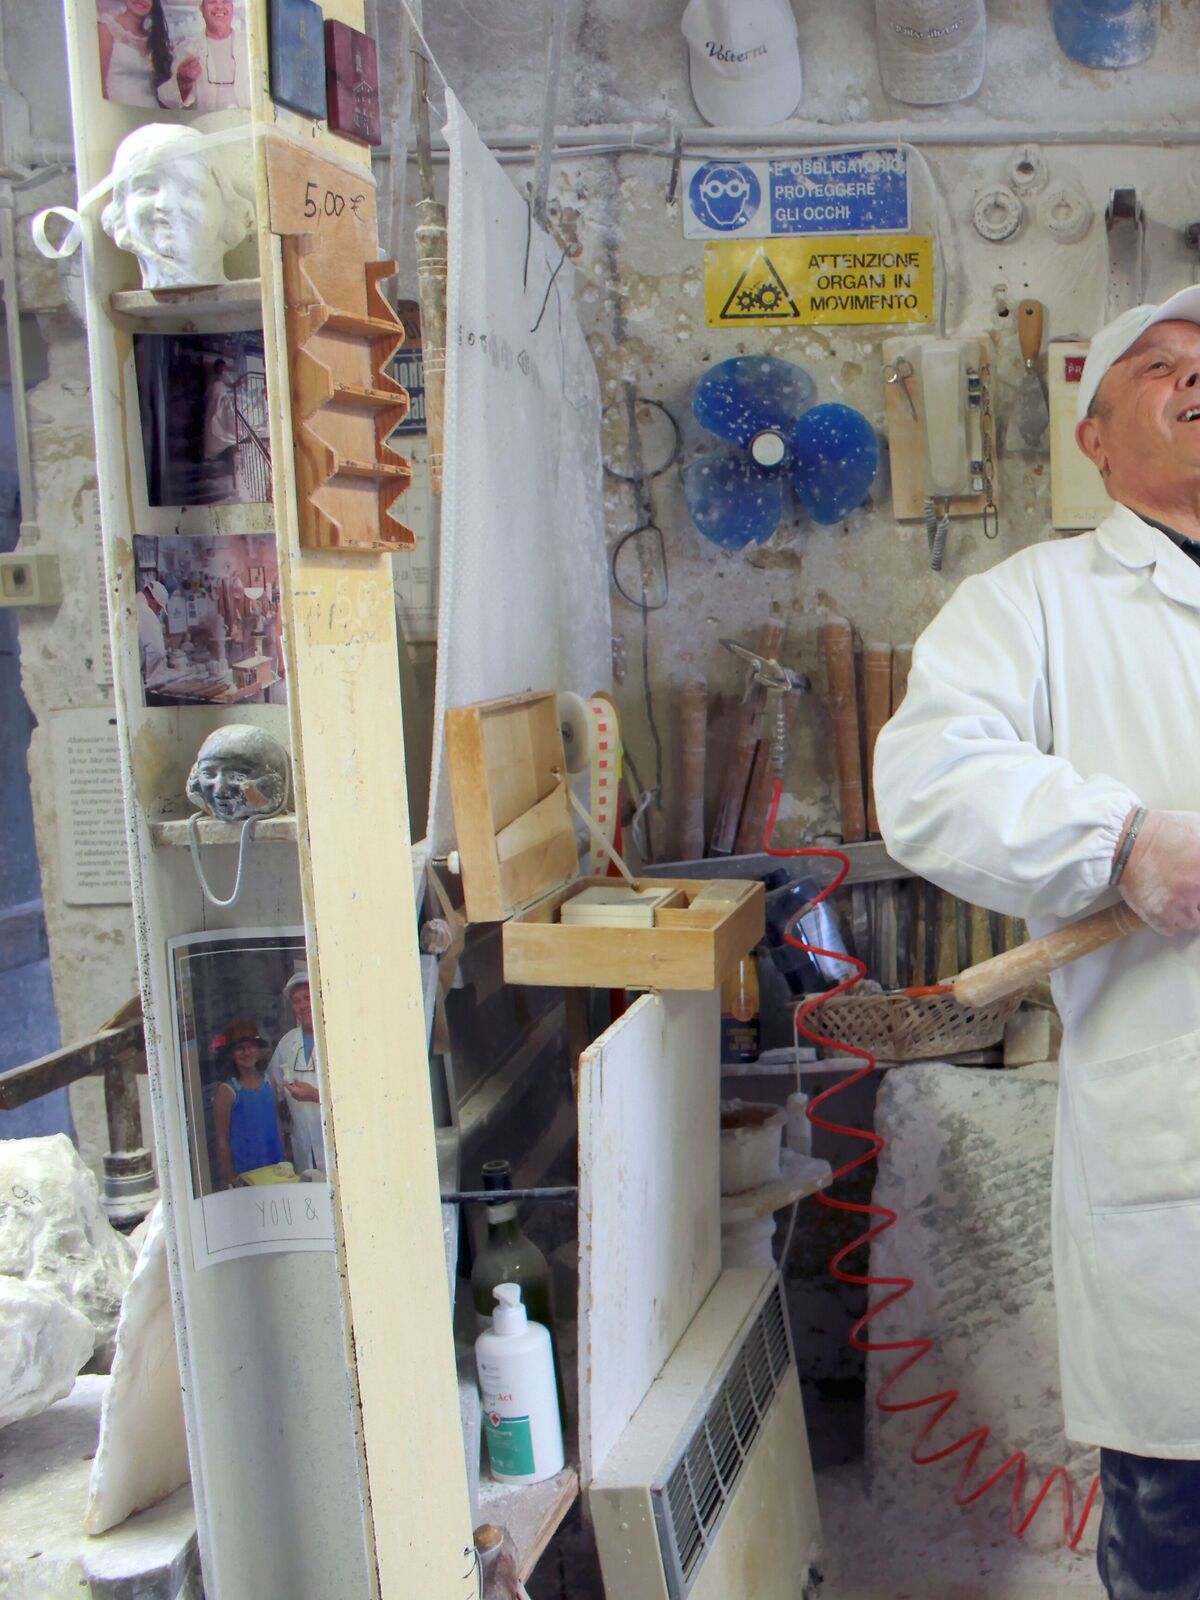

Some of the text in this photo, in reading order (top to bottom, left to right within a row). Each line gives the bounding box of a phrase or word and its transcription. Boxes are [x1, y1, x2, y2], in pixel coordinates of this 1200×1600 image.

[791, 156, 900, 175] OBBLIGATORIO
[775, 183, 876, 198] PROTEGGERE
[304, 182, 346, 226] 5,00
[775, 205, 850, 221] GLI OCCHI
[808, 253, 920, 269] ATTENZIONE
[817, 274, 911, 289] ORGANI IN
[810, 295, 918, 311] MOVIMENTO
[255, 1196, 320, 1228] YOU &
